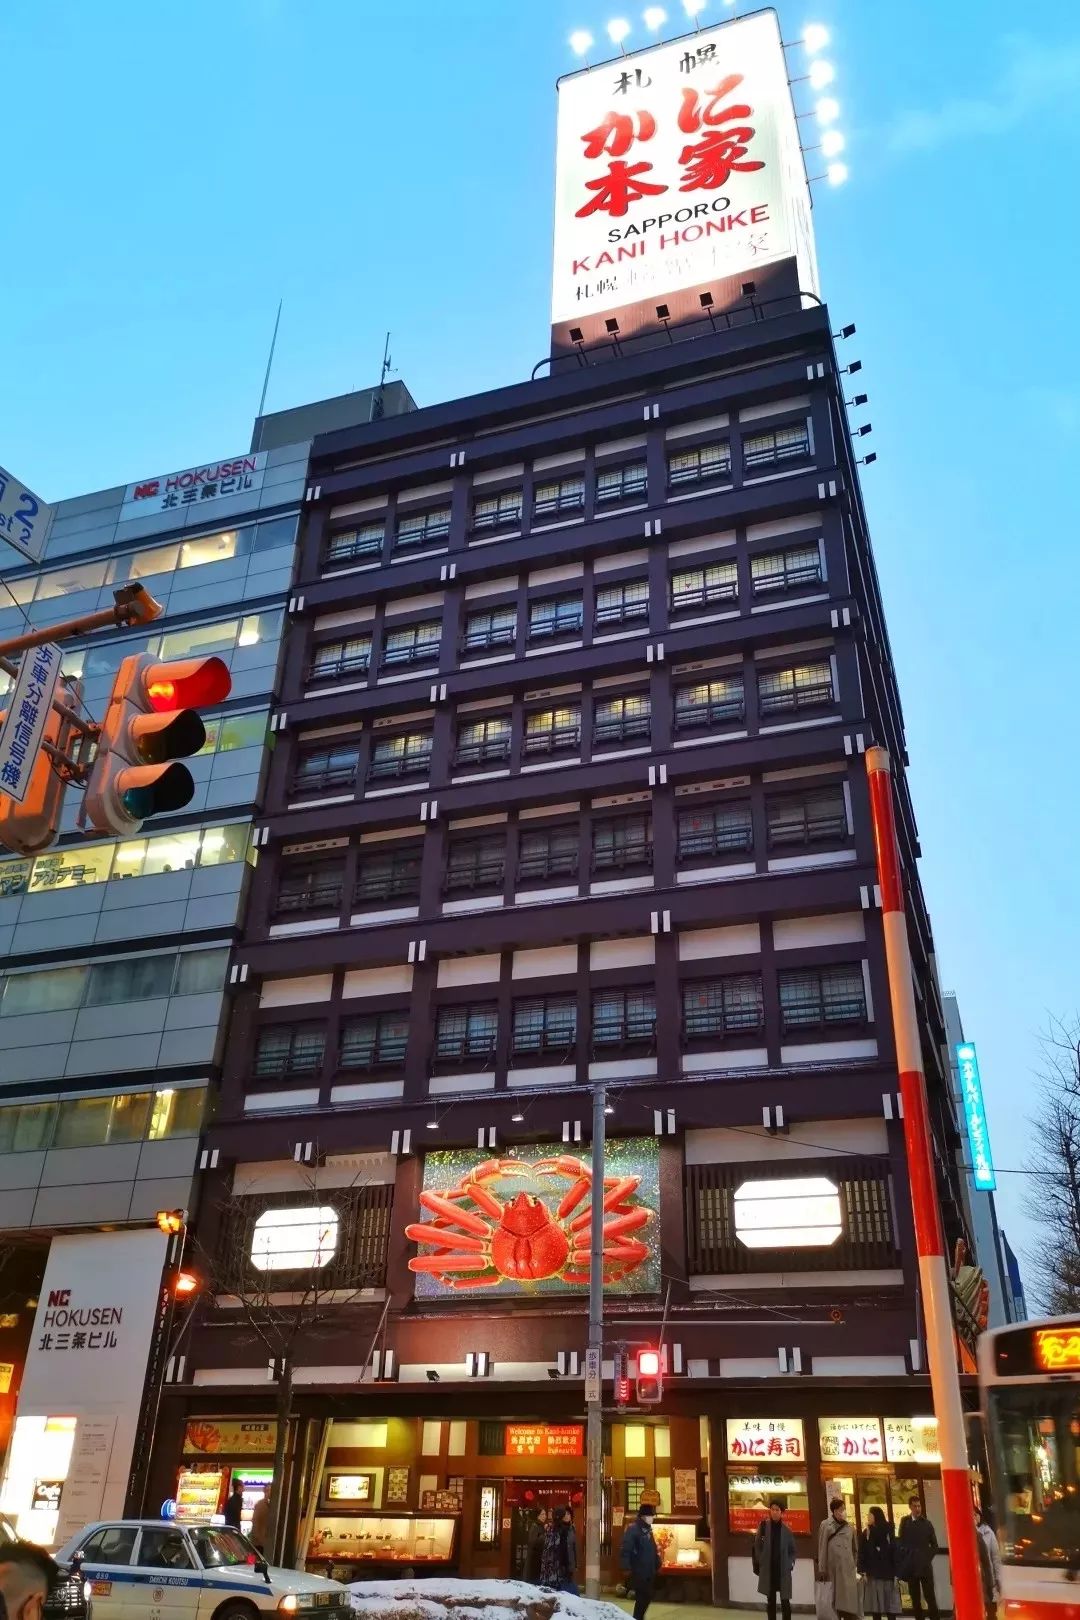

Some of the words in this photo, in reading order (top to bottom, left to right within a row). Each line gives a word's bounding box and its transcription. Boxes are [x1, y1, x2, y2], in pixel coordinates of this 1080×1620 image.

[580, 73, 755, 159] かに
[574, 126, 767, 218] 本家
[571, 239, 645, 275] KANI
[659, 203, 771, 250] HONKE
[607, 196, 731, 243] SAPPORO
[164, 456, 257, 492] HOKUSEN
[43, 1307, 123, 1329] HOKUSEN
[38, 1331, 118, 1351] 北三条ビル
[588, 1351, 597, 1399] 歩車分式
[731, 1436, 801, 1457] かに寿司
[842, 1436, 880, 1456] かに
